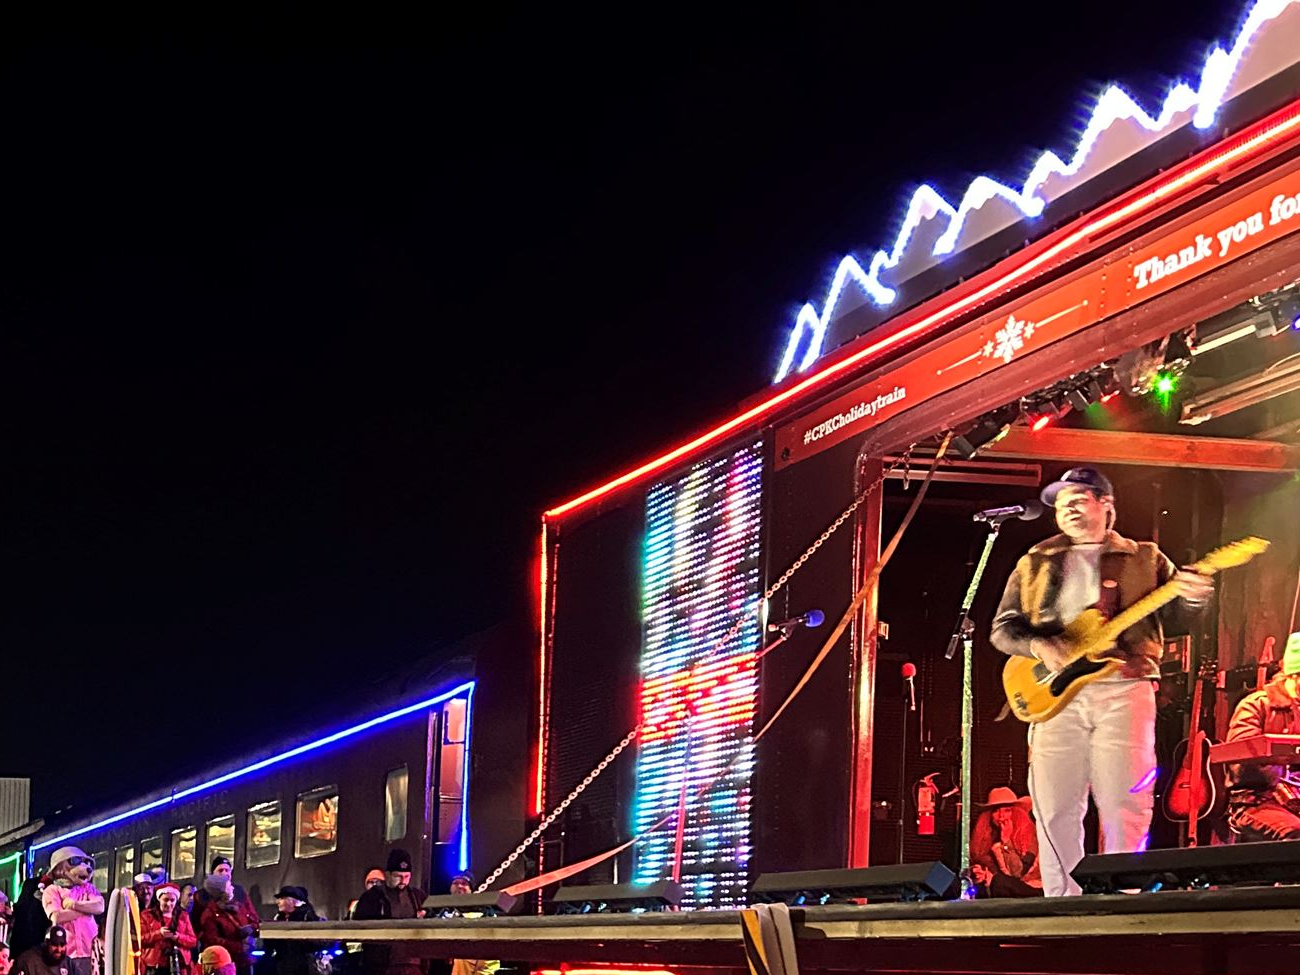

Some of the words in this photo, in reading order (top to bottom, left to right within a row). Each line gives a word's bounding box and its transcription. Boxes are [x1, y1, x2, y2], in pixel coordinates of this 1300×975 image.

[1133, 233, 1213, 290] Thank
[1217, 211, 1264, 257] you
[803, 386, 906, 445] #CPKCholidaytrain
